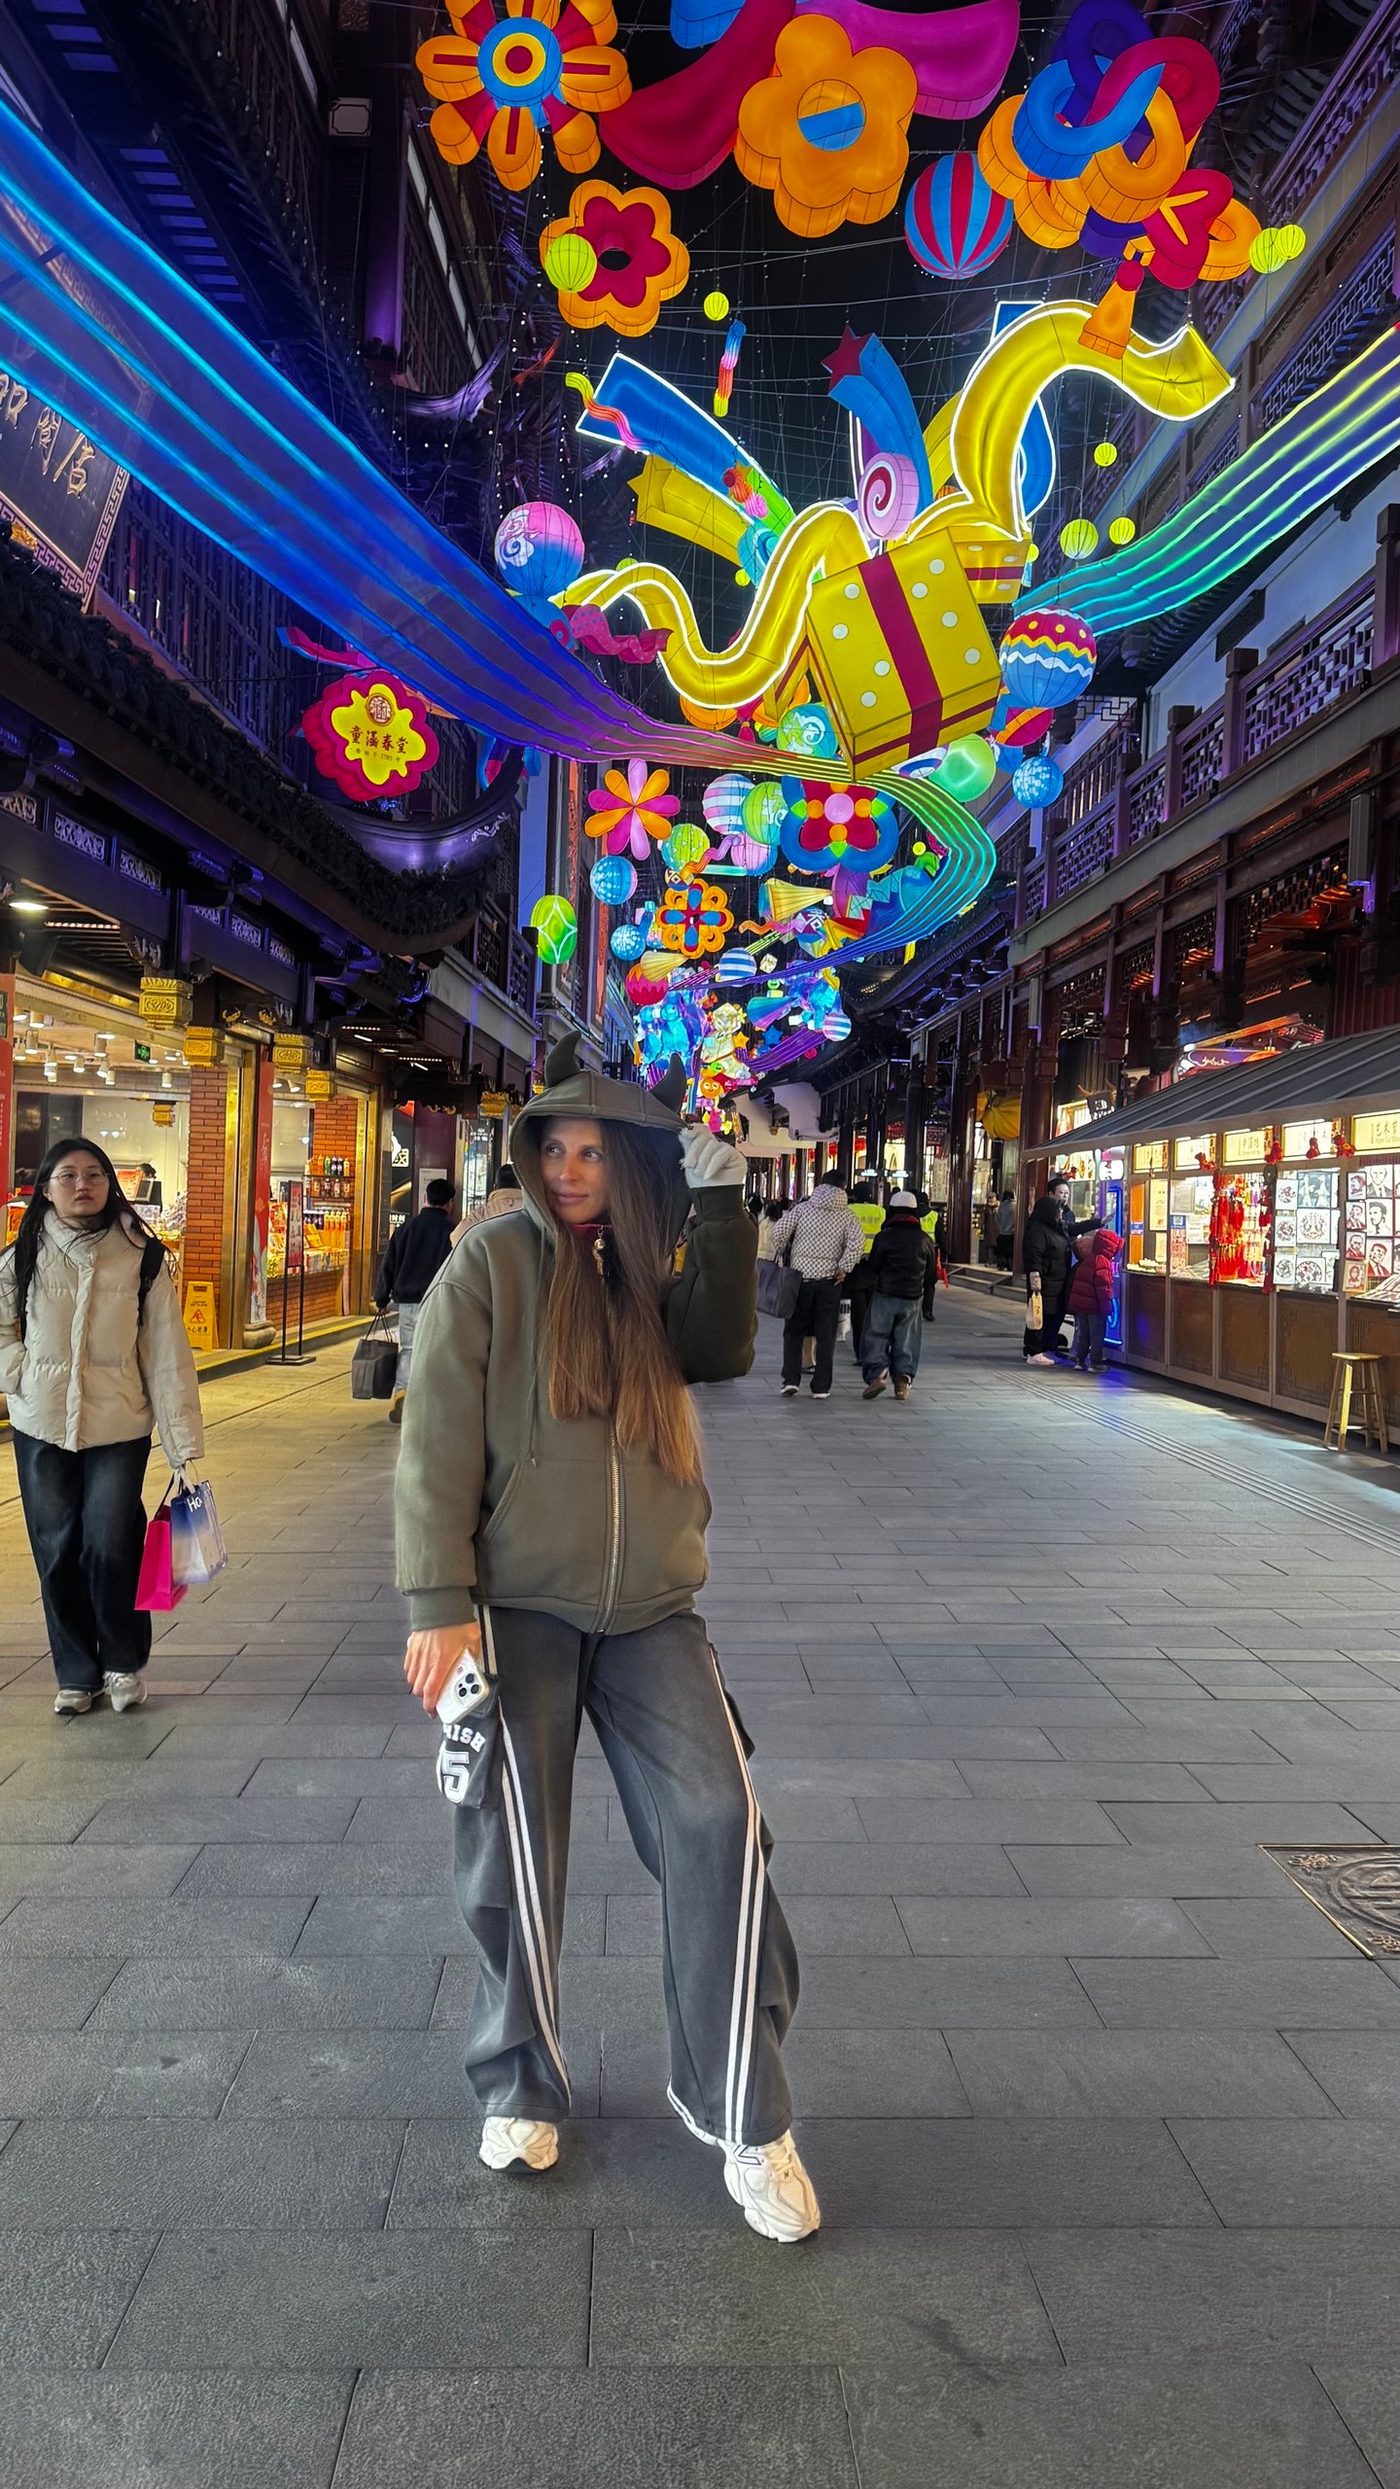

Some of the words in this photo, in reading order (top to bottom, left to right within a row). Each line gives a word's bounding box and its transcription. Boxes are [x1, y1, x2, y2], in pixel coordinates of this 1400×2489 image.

[350, 725, 409, 755] 童涵春堂
[441, 1750, 470, 1804] 5
